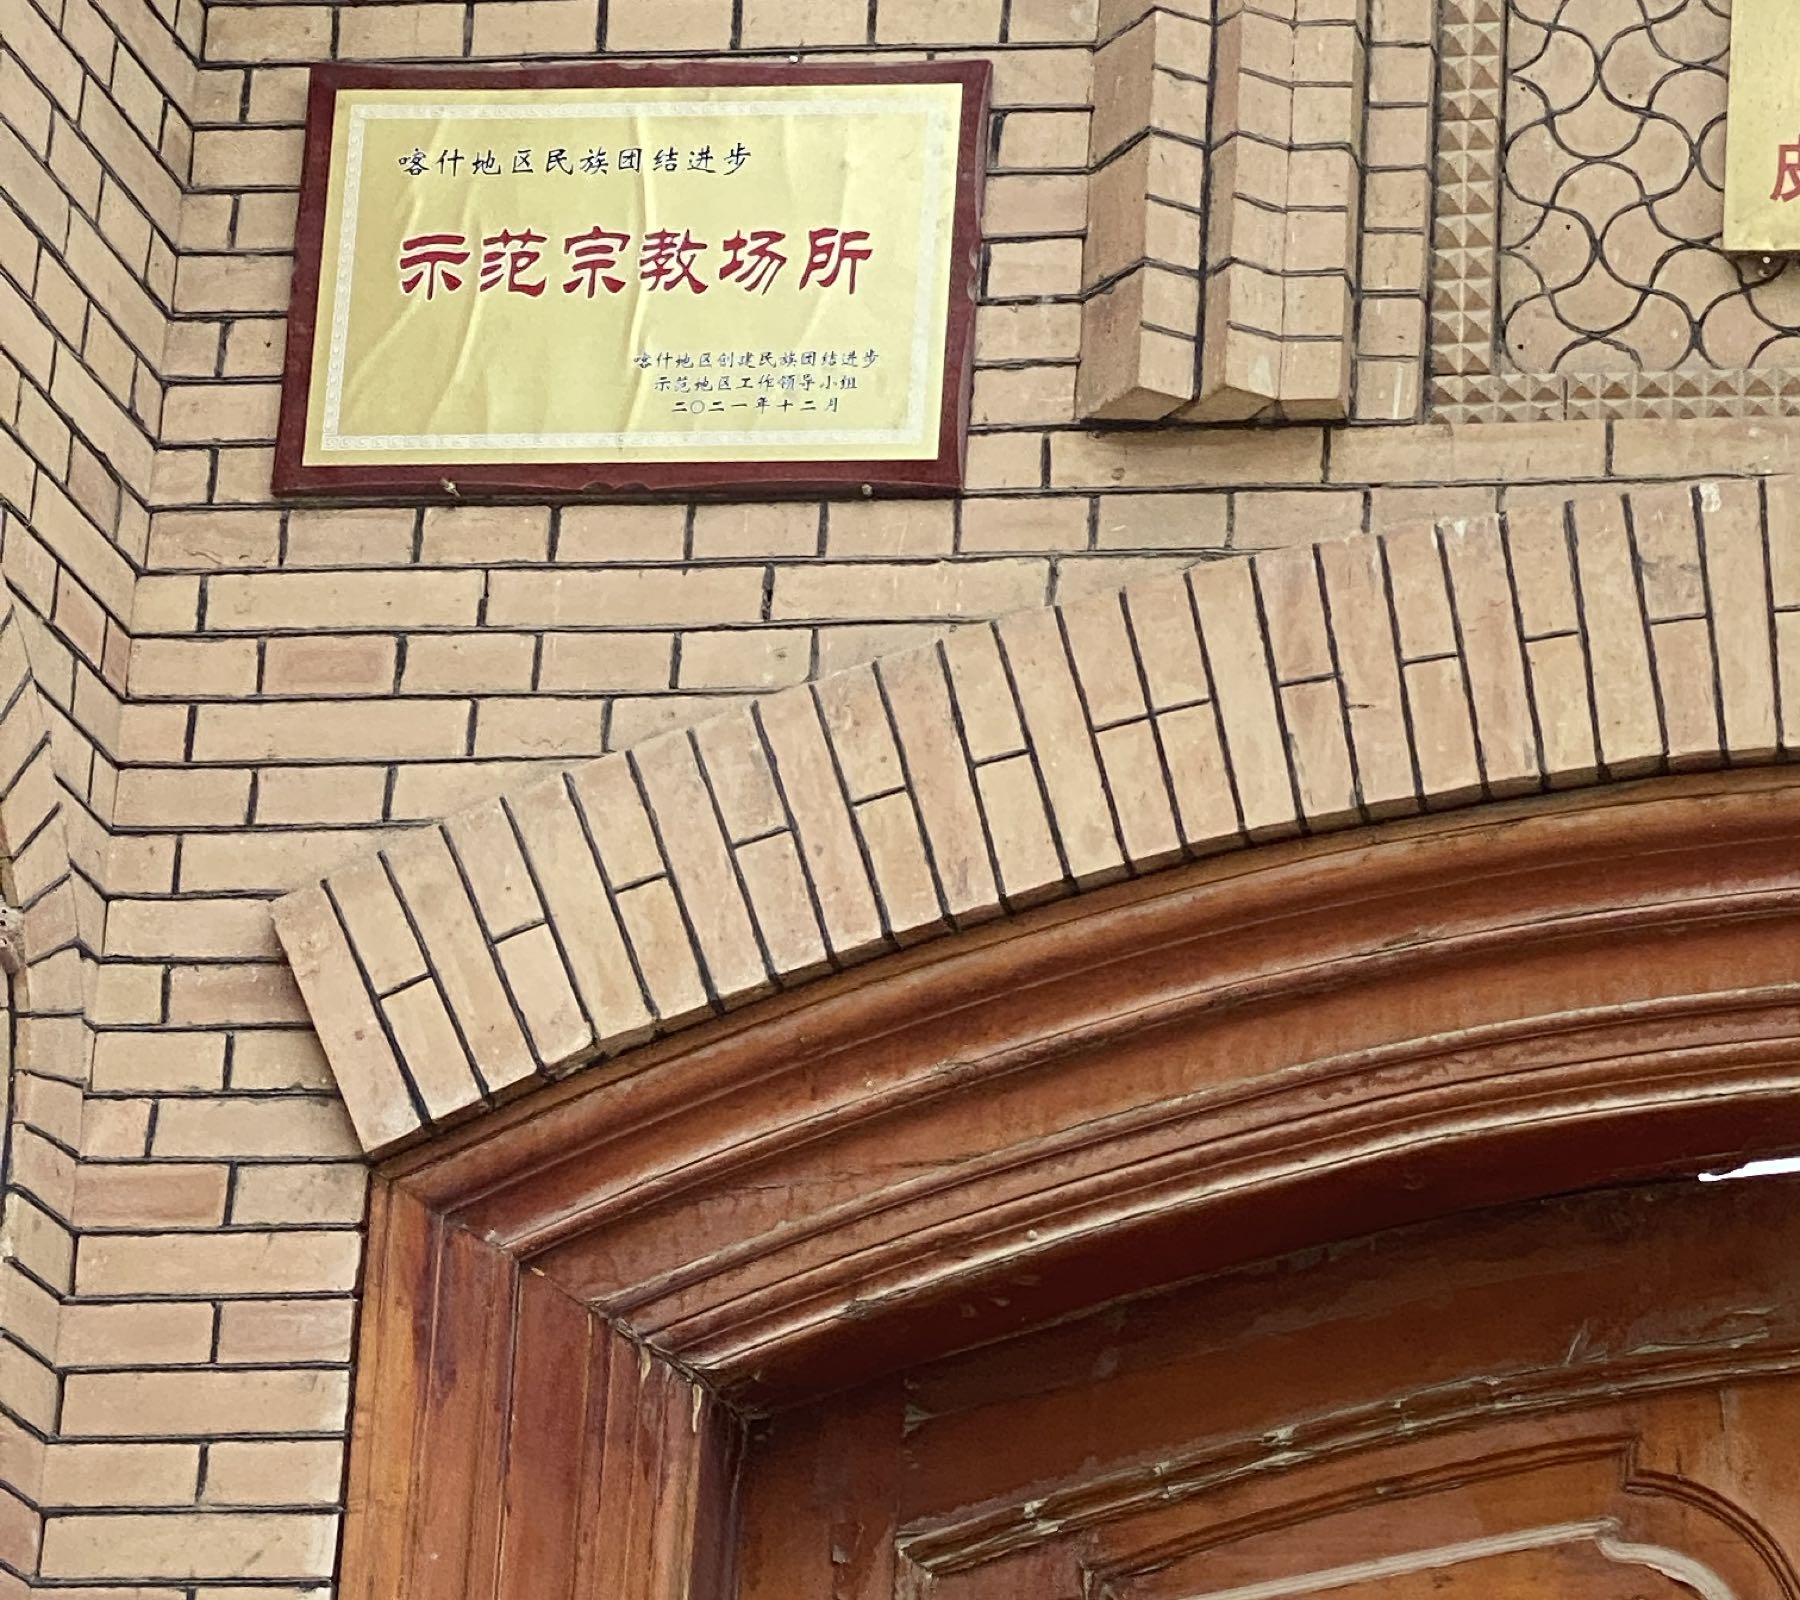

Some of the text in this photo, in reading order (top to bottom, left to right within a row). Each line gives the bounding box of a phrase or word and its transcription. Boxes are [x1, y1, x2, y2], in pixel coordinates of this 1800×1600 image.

[397, 147, 752, 177] 喀什地区民族团结进步
[398, 225, 875, 300] 示范宗教场所
[632, 348, 882, 370] 喀什地区创建民族团结进步
[654, 372, 860, 394] 示范地区工作领导小组
